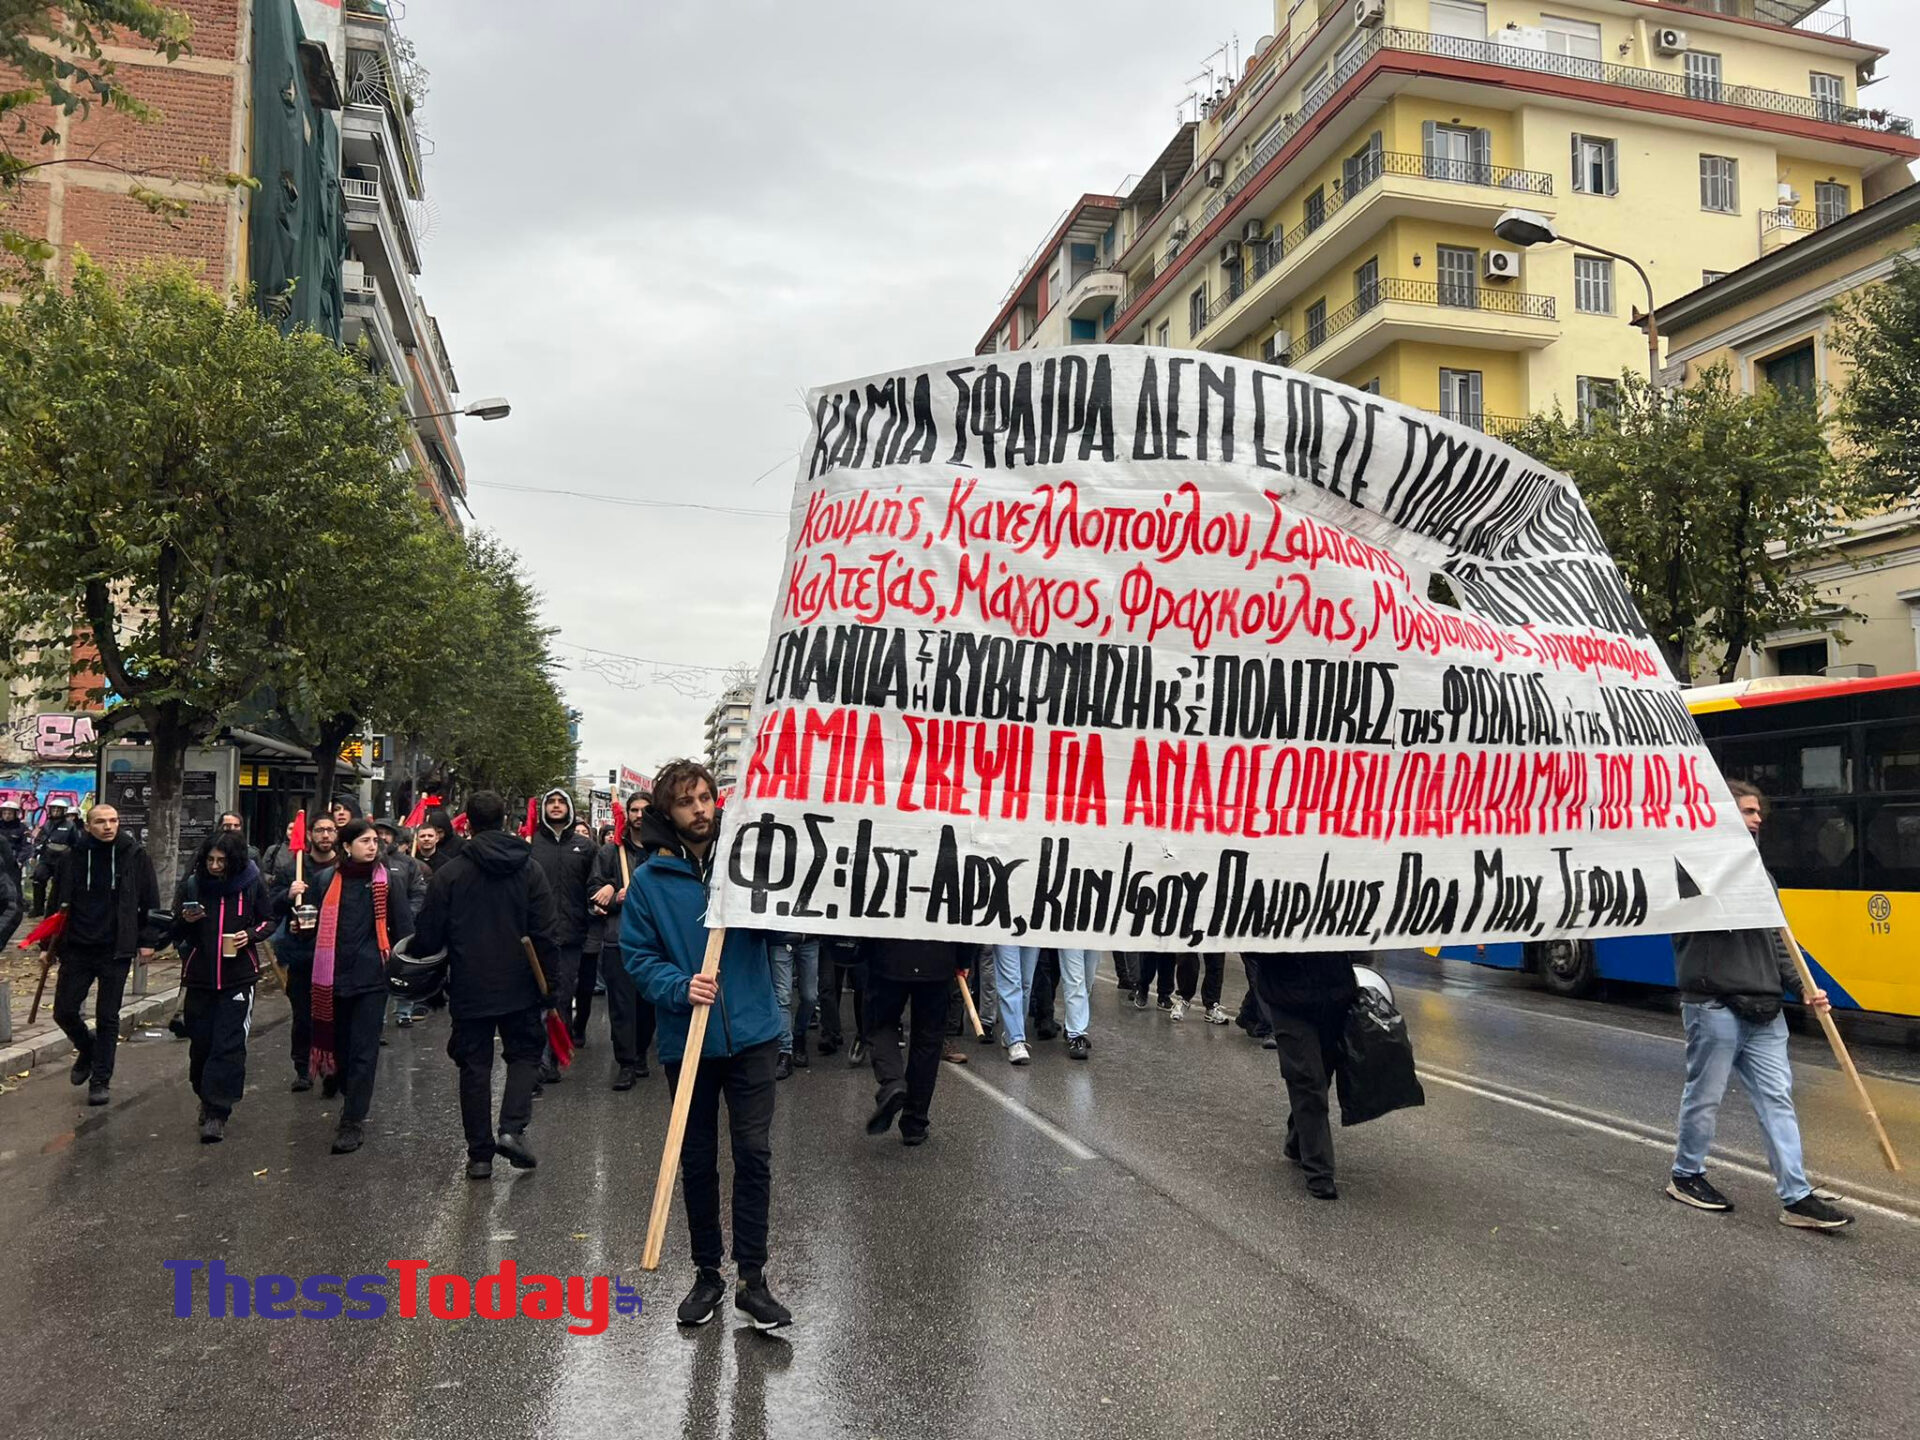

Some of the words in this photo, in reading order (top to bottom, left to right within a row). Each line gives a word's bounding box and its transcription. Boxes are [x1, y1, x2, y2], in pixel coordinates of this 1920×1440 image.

[808, 372, 938, 481] ΚΑΜΙΑ
[946, 353, 1115, 469] ΣΦΑΙΡΑ
[1132, 356, 1235, 463] ΔΕΝ
[1253, 370, 1385, 508] ΕΠΕΣΕ
[795, 485, 933, 552] Κουμής,
[940, 477, 1259, 571] Κανελλοπούλου,
[783, 549, 946, 625] Καλτεζάς,
[950, 552, 1112, 638] Μάγγος,
[1120, 561, 1367, 652] Φραγκούλης,
[932, 630, 1152, 730] ΚΥΒΕΡΝΗΣΗ
[1209, 655, 1399, 746] ΠΟΛΙΤΙΚΕΣ
[744, 707, 887, 806] ΚΑΜΙΑ
[896, 714, 1034, 821] ΣΚΕΨΗ
[1045, 730, 1107, 827] ΓΙΑ
[1595, 752, 1634, 830] ΤΟΥ
[1550, 847, 1648, 930] ΤΕΦΑΑ
[1870, 922, 1891, 934] 119
